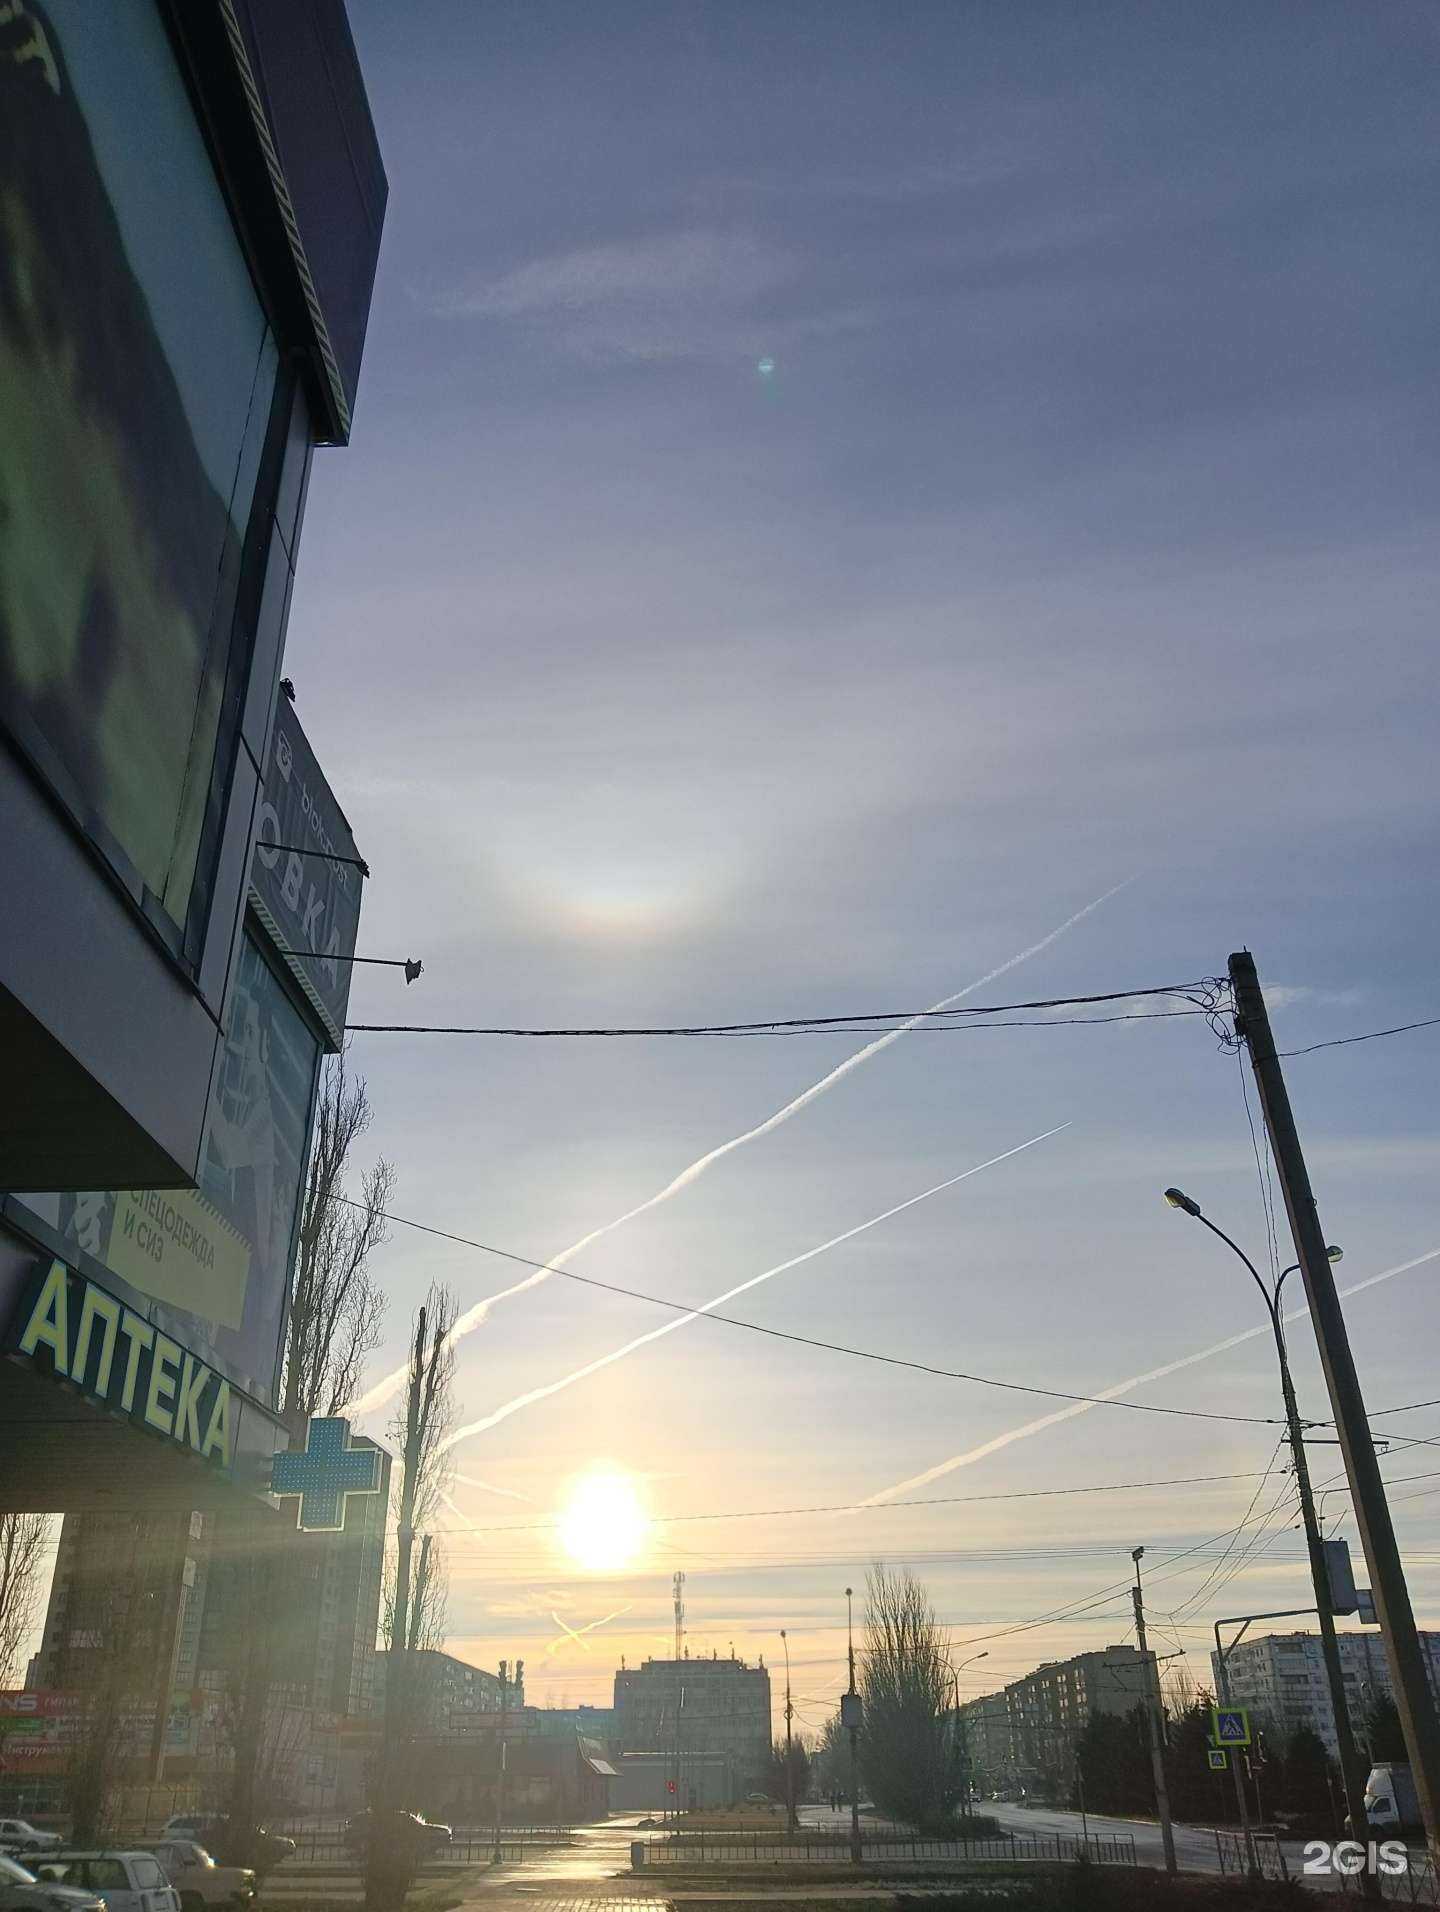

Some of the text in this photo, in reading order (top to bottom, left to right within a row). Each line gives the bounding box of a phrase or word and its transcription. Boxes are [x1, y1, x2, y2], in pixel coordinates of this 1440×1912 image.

[122, 1208, 165, 1263] И СИЗ
[18, 1258, 231, 1467] АПТЕКА
